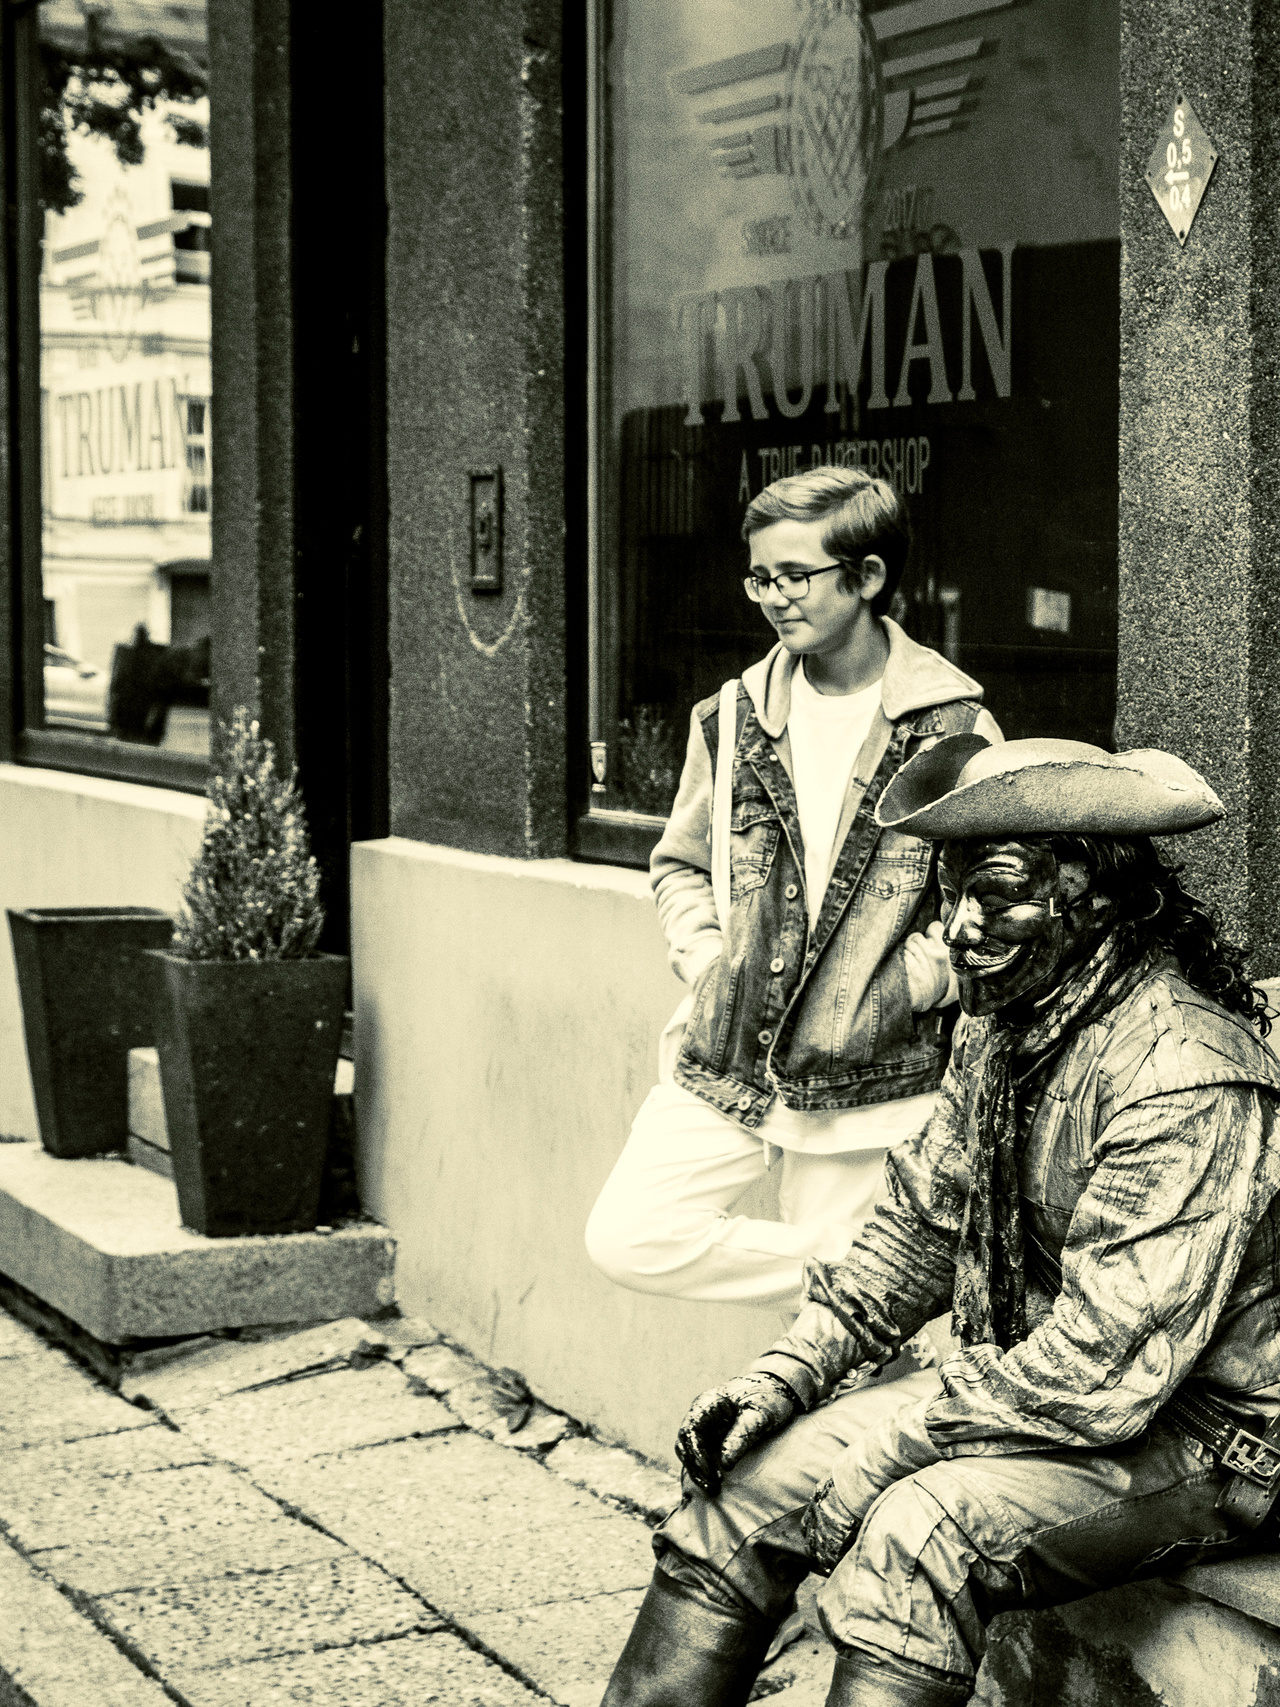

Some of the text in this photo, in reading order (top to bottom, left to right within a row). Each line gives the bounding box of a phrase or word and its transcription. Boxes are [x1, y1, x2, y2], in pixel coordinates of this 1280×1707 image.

[1172, 108, 1185, 138] S
[672, 241, 1017, 427] TRUMAN
[58, 373, 190, 478] TRUMAN
[738, 449, 750, 502] A
